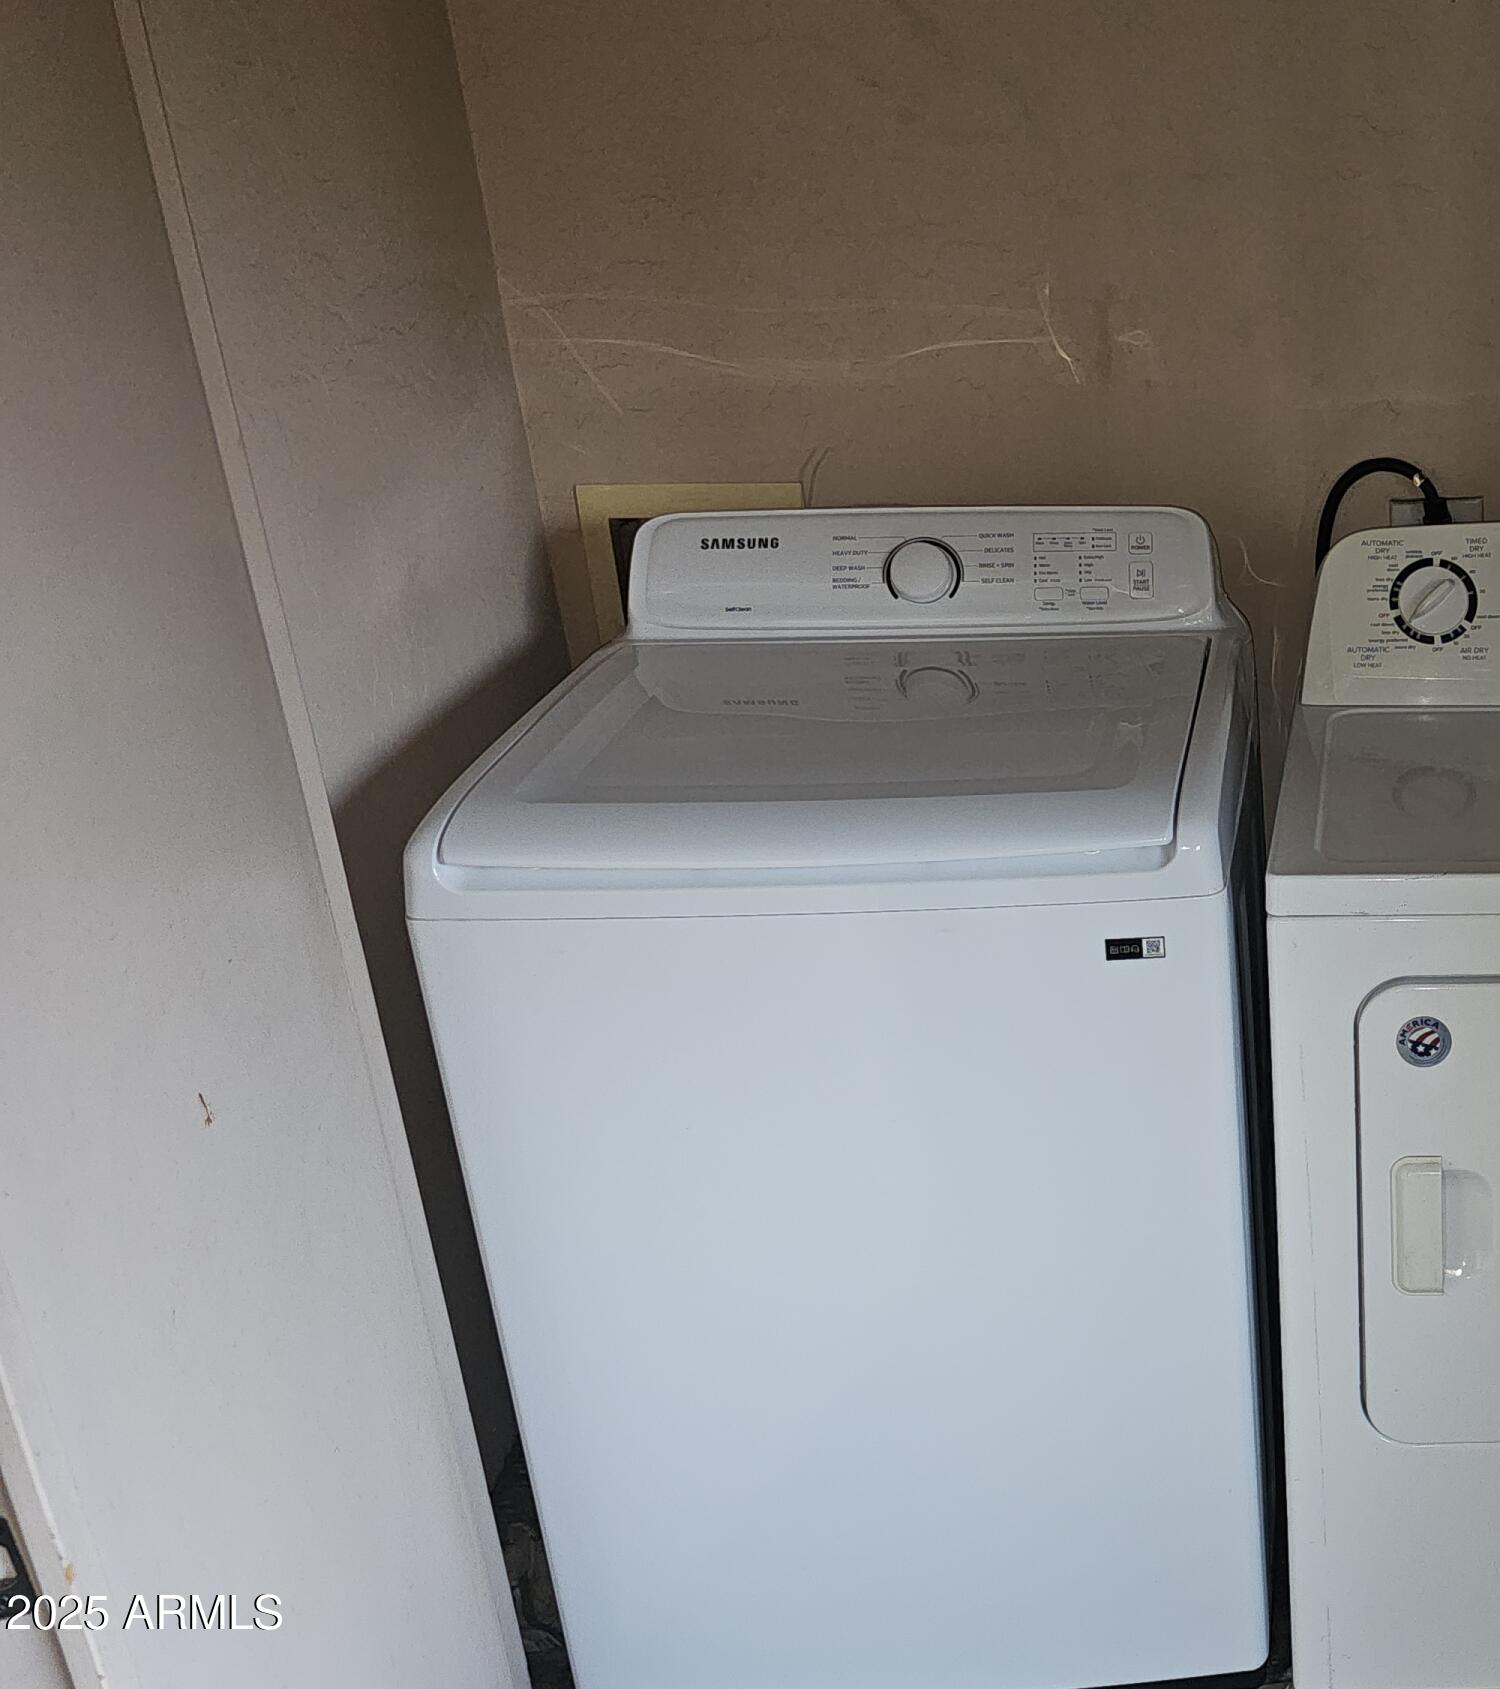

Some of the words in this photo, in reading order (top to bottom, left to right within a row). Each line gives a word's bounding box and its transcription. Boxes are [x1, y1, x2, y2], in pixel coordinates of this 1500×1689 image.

[700, 537, 780, 550] SAMSUNG
[1361, 539, 1405, 547] AUTOMATIC
[1398, 1018, 1440, 1046] AMERICA
